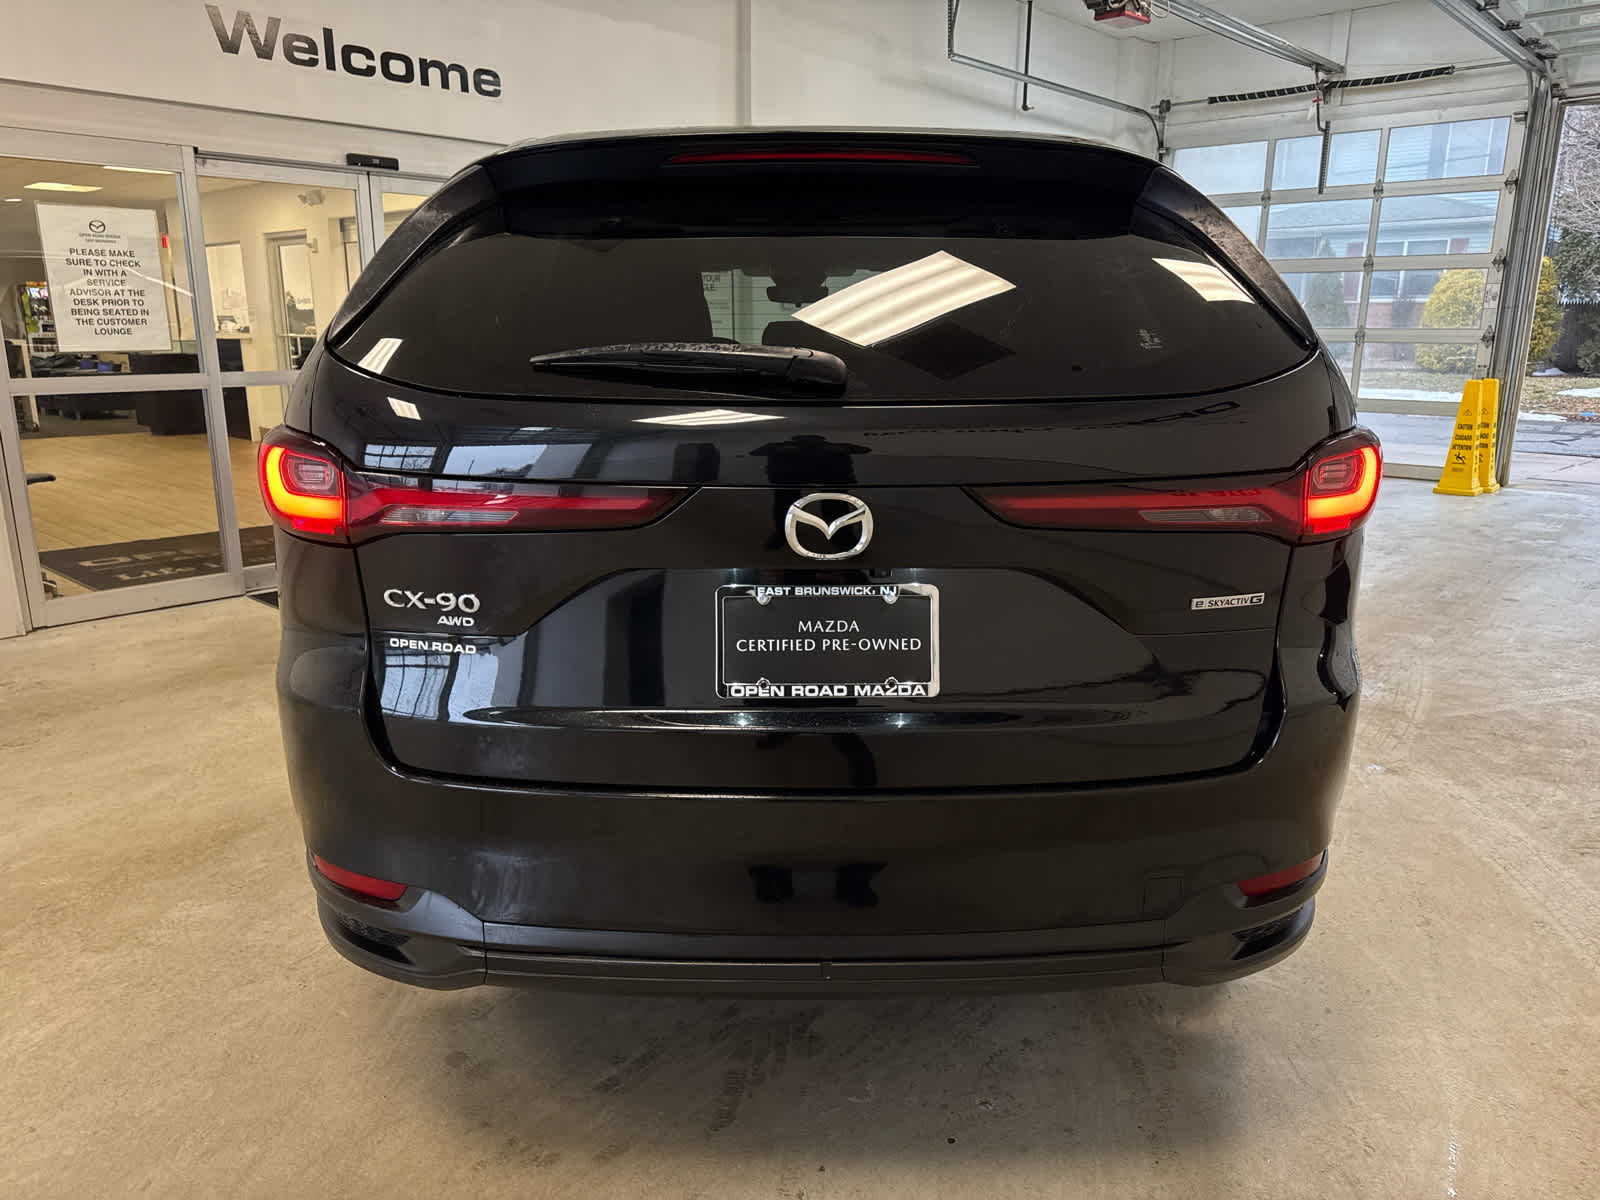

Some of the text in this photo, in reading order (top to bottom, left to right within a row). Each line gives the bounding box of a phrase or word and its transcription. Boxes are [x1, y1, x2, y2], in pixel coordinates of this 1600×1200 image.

[204, 3, 501, 98] Welcome
[69, 248, 107, 257] PLEASE
[65, 258, 91, 266] SURE
[109, 260, 141, 268] CHECK
[70, 288, 111, 296] ADVISOR
[74, 298, 99, 306] DESK
[76, 318, 147, 326] THE CUSTOMER
[94, 328, 132, 336] LOUNGE
[757, 586, 792, 596] EAST
[880, 586, 897, 596] NJ
[384, 588, 480, 614] CX-90
[437, 616, 474, 626] AWD
[798, 620, 860, 632] MAZDA
[390, 638, 476, 654] OPEN ROAD
[736, 638, 922, 652] CERTIFIED PRE-OWNED
[730, 684, 926, 697] OPEN ROAD MAZDA
